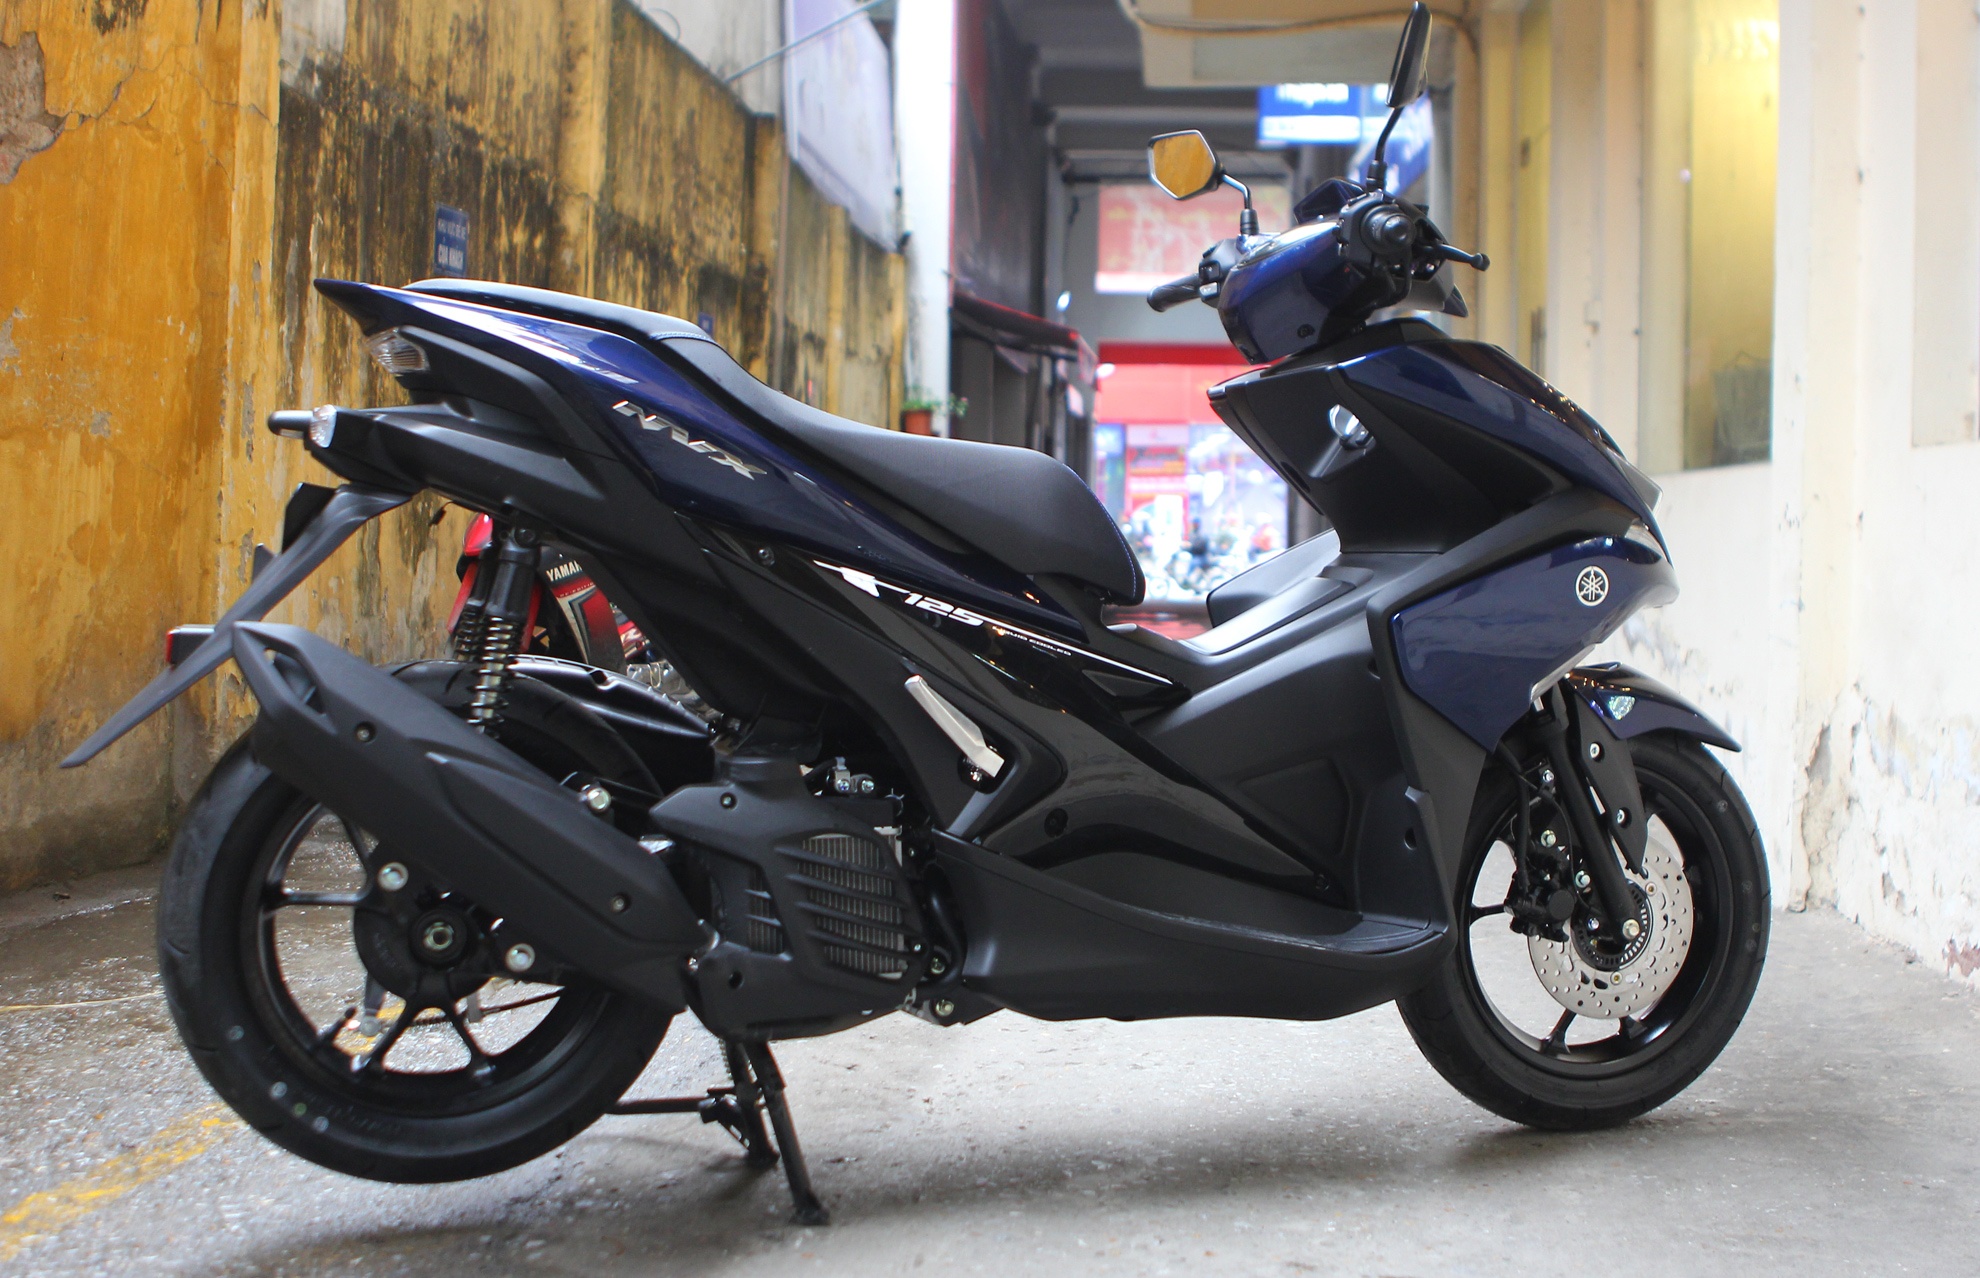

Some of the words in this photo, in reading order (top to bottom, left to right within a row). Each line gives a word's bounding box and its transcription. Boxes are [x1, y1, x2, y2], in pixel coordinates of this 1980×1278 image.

[545, 560, 583, 582] YAMAH
[904, 592, 984, 627] 125
[992, 625, 1028, 641] LQUID
